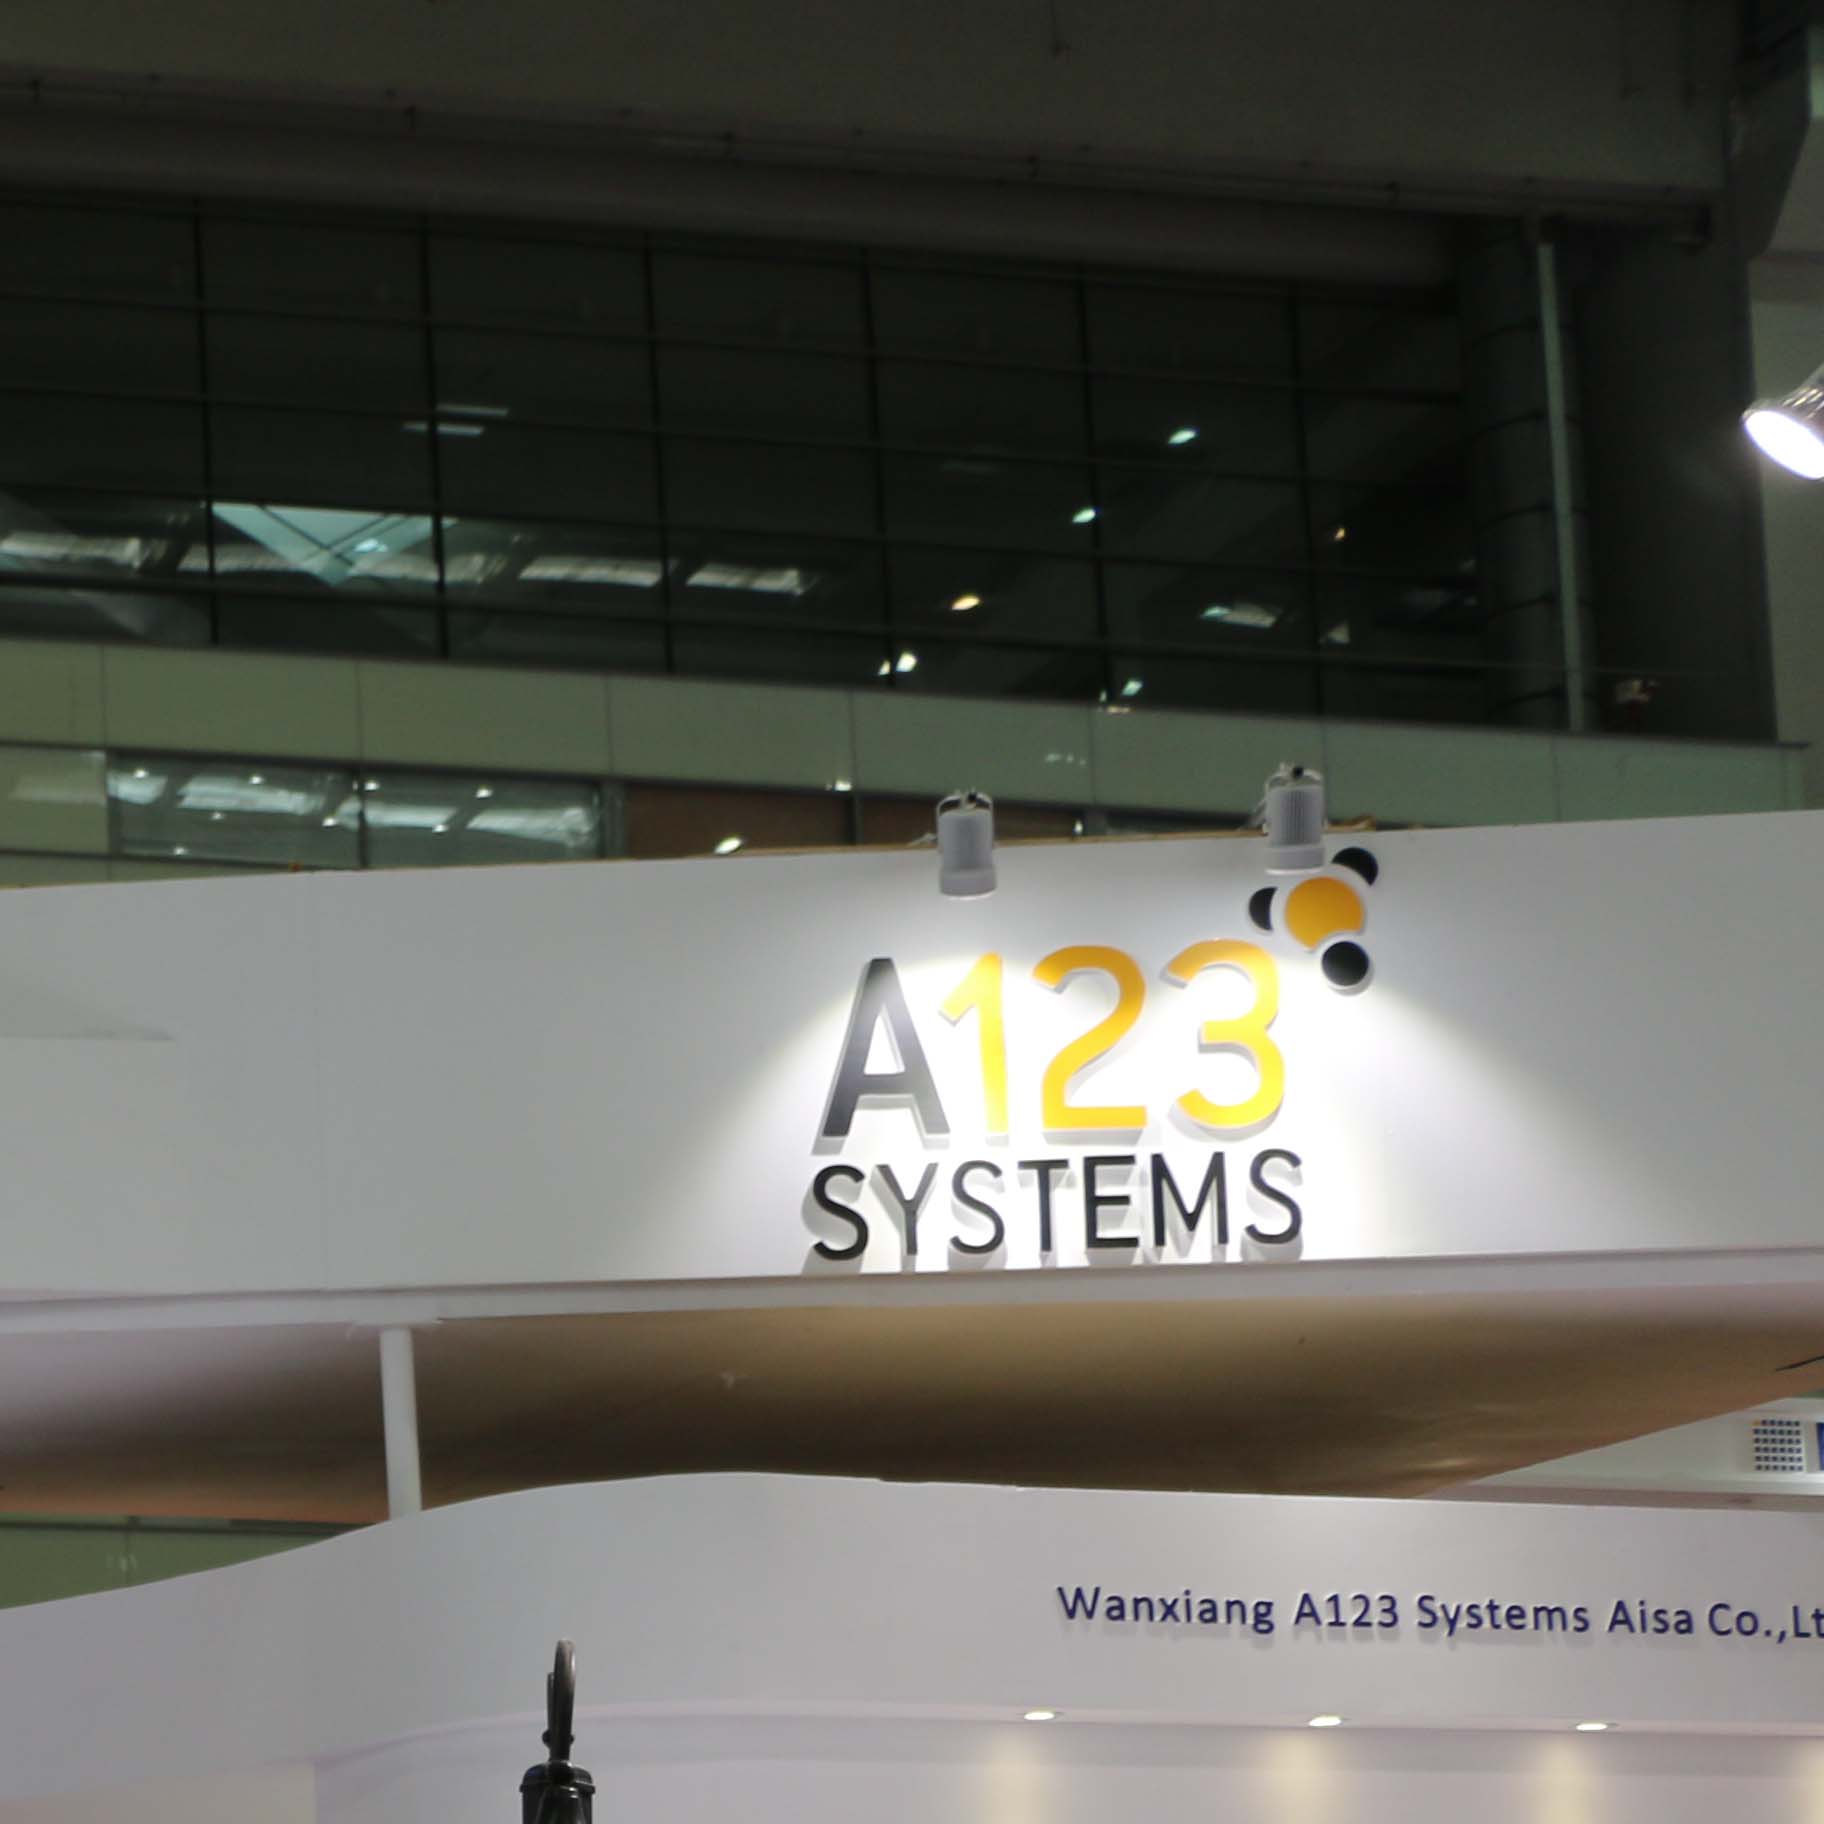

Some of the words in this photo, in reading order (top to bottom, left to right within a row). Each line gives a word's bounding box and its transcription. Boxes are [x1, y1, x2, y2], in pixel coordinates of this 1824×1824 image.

[818, 938, 1286, 1140] A123
[812, 1148, 1302, 1261] SYSTEMS
[1057, 1585, 1275, 1635] Wanxiang
[1294, 1592, 1399, 1629] A123
[1416, 1595, 1590, 1638] Systems
[1607, 1599, 1694, 1637] Aisa
